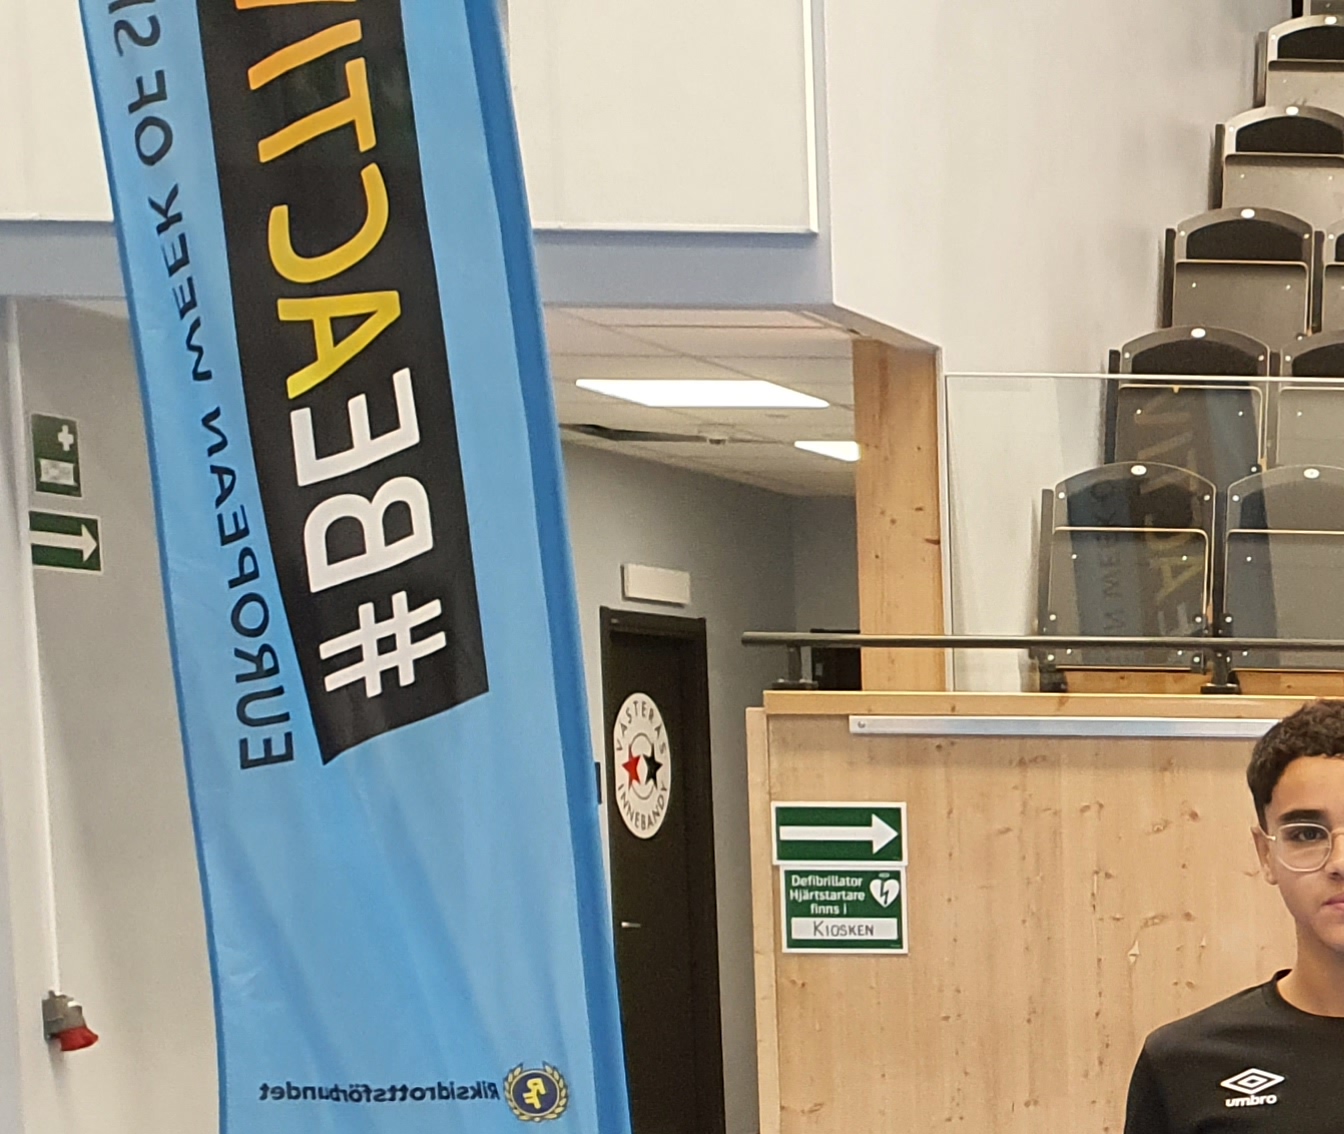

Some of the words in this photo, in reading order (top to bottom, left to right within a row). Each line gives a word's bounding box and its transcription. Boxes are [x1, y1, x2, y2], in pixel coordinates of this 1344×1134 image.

[618, 783, 668, 831] INNEBANDY
[791, 875, 863, 887] Defibrillator
[789, 889, 865, 902] Hjärtstartare
[810, 903, 840, 915] finns
[1225, 1094, 1277, 1107] umbro
